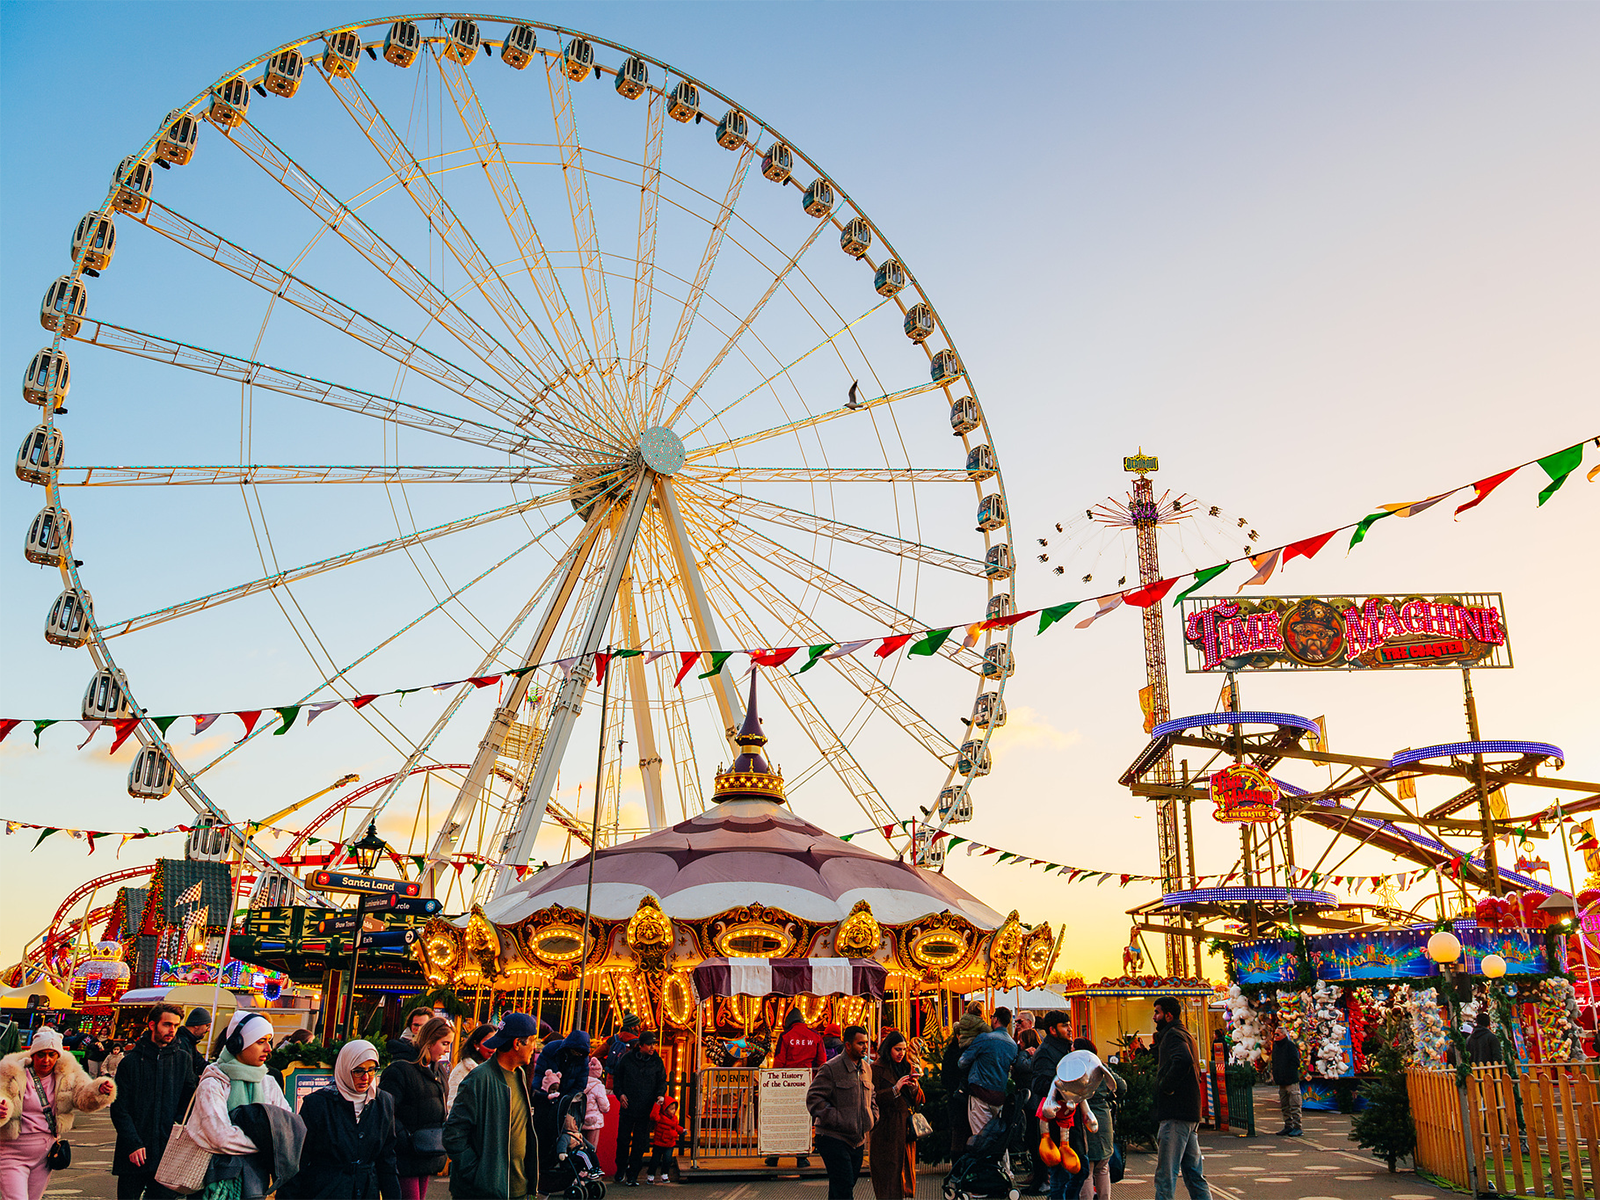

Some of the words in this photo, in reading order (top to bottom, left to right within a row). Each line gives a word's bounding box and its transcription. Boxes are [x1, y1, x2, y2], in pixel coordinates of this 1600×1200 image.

[1187, 599, 1284, 670] TIME
[1342, 598, 1505, 660] MACHINE
[1382, 645, 1409, 660] THE
[1409, 640, 1465, 657] COASTER
[342, 876, 370, 888] Santa
[371, 880, 395, 891] Land
[396, 902, 410, 910] rcle
[363, 936, 373, 944] Exit
[790, 1038, 814, 1046] CREW
[767, 1072, 779, 1080] The
[781, 1072, 804, 1080] History
[762, 1080, 769, 1088] of
[771, 1080, 781, 1088] the
